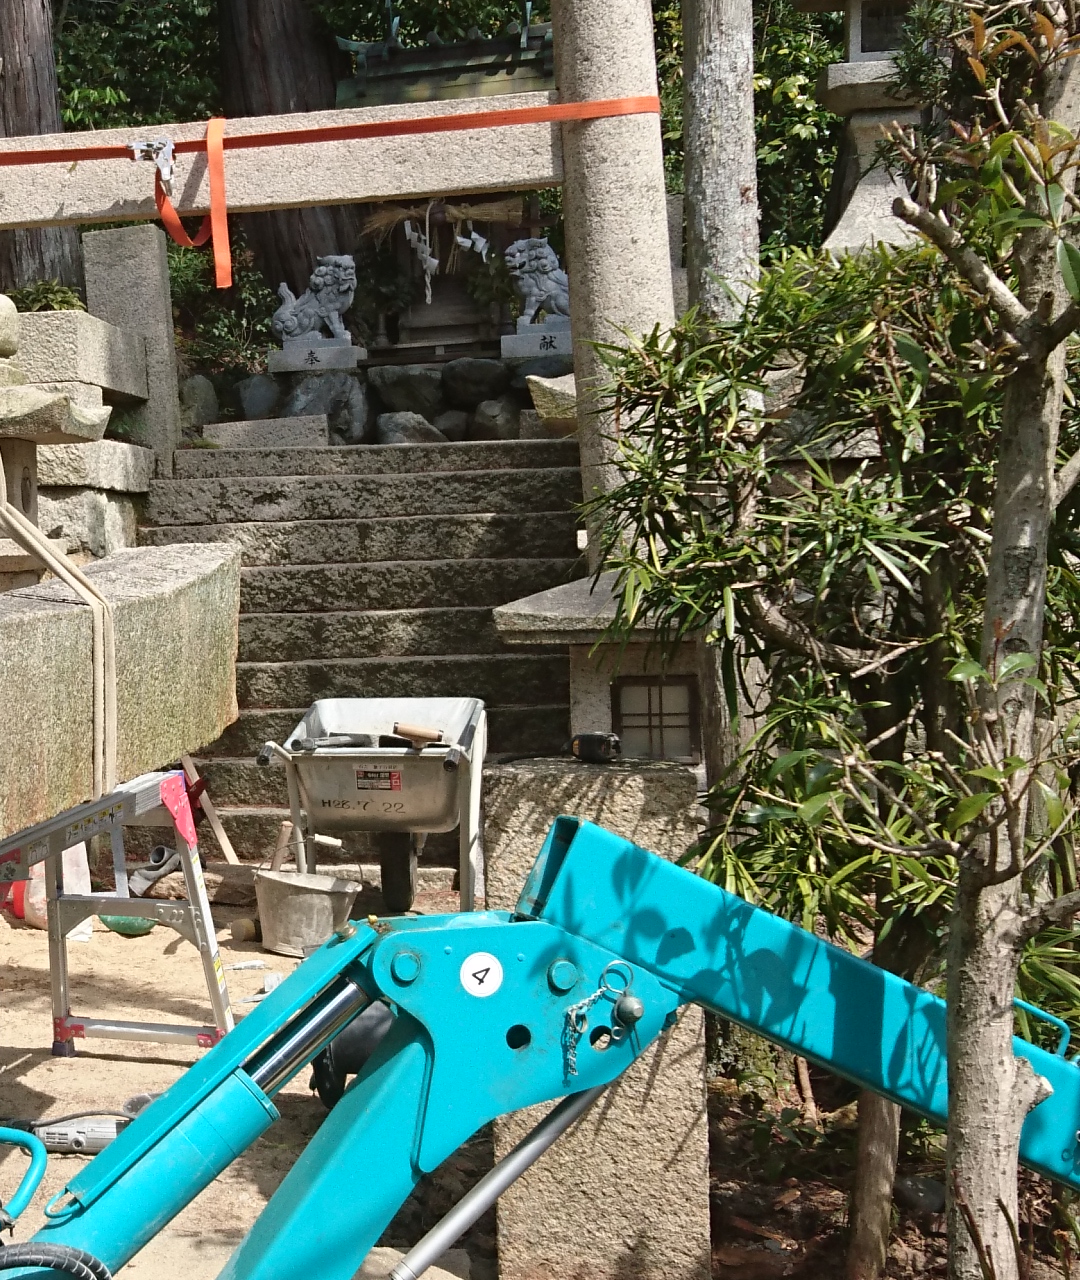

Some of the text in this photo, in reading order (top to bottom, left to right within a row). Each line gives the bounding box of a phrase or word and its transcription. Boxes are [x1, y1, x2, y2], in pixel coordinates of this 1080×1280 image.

[539, 335, 558, 351] 献
[304, 350, 321, 367] 奉
[472, 967, 491, 986] 4
